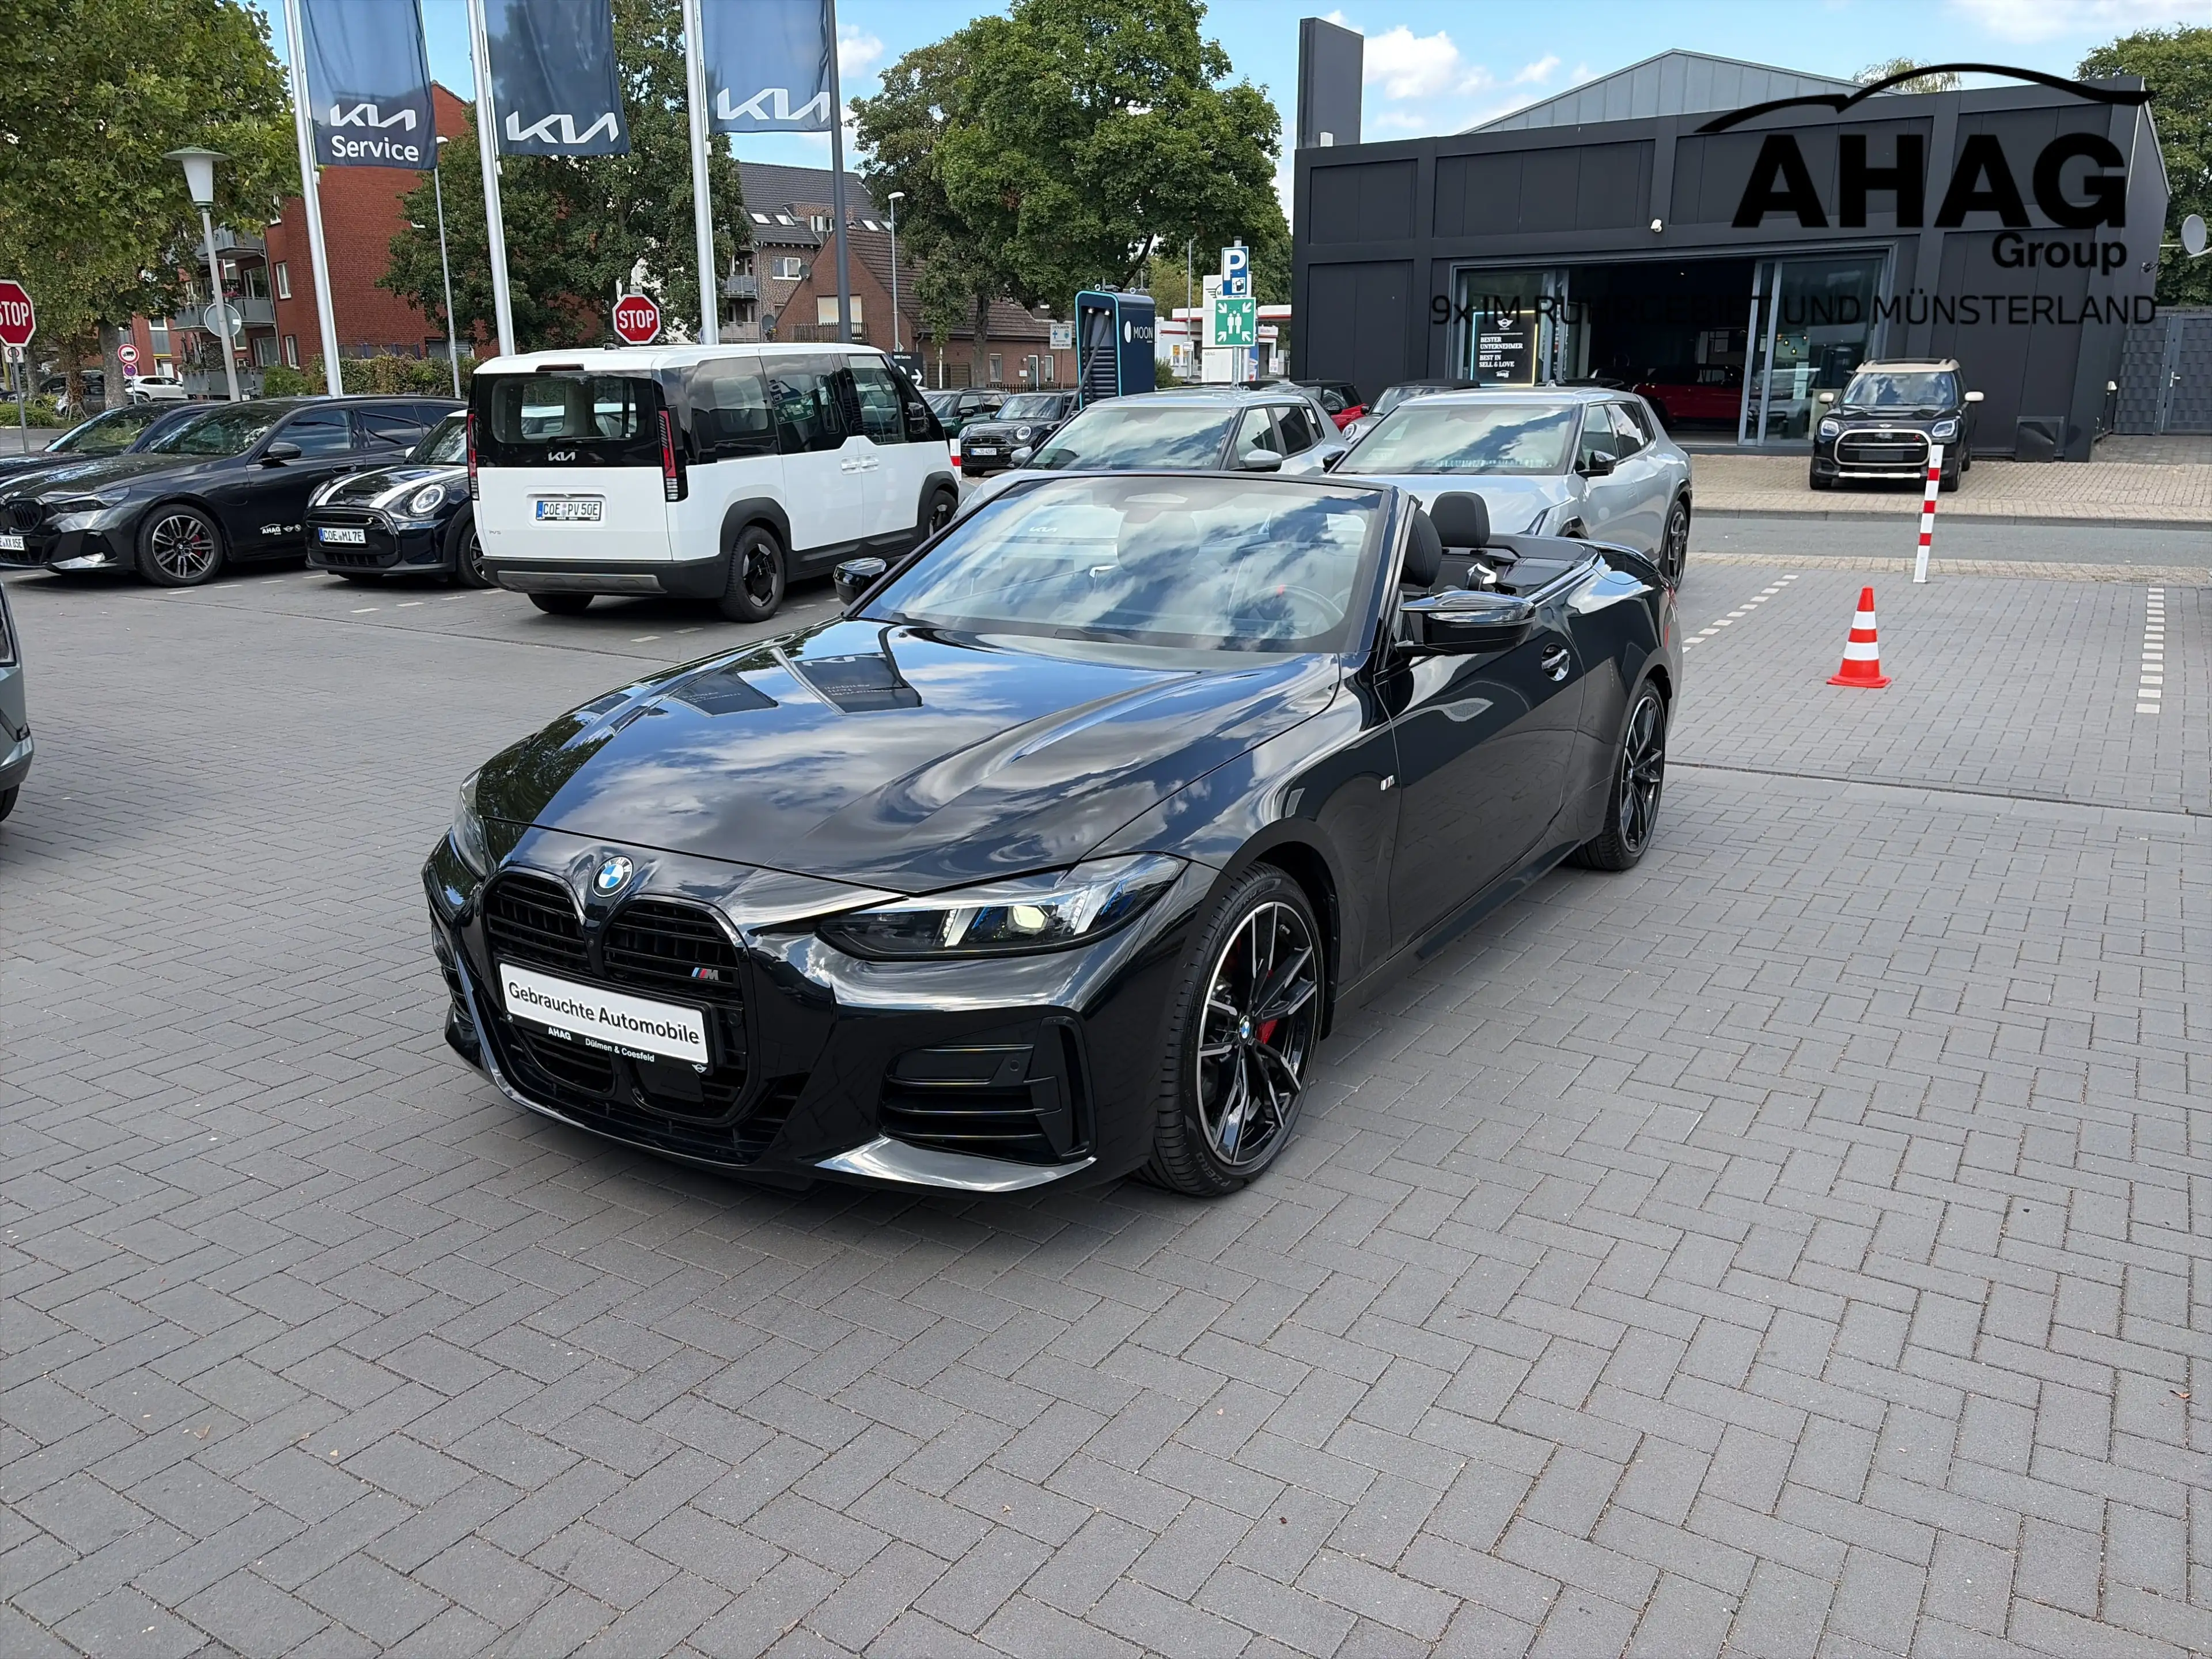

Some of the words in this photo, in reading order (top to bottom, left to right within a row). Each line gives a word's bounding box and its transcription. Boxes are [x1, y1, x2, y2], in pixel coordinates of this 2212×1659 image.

[330, 104, 416, 131] KIA
[717, 88, 830, 122] KIA
[506, 111, 619, 143] KIA
[331, 135, 419, 162] Service
[618, 309, 655, 329] STOP
[1133, 326, 1153, 339] MOON
[548, 452, 575, 461] KIA
[508, 982, 596, 1021] Gebrauchte
[598, 1007, 700, 1044] Automobile
[548, 1027, 572, 1041] AHAG
[585, 1037, 613, 1053] Dülmen
[614, 1046, 620, 1054] &
[622, 1047, 655, 1063] Coesfeld
